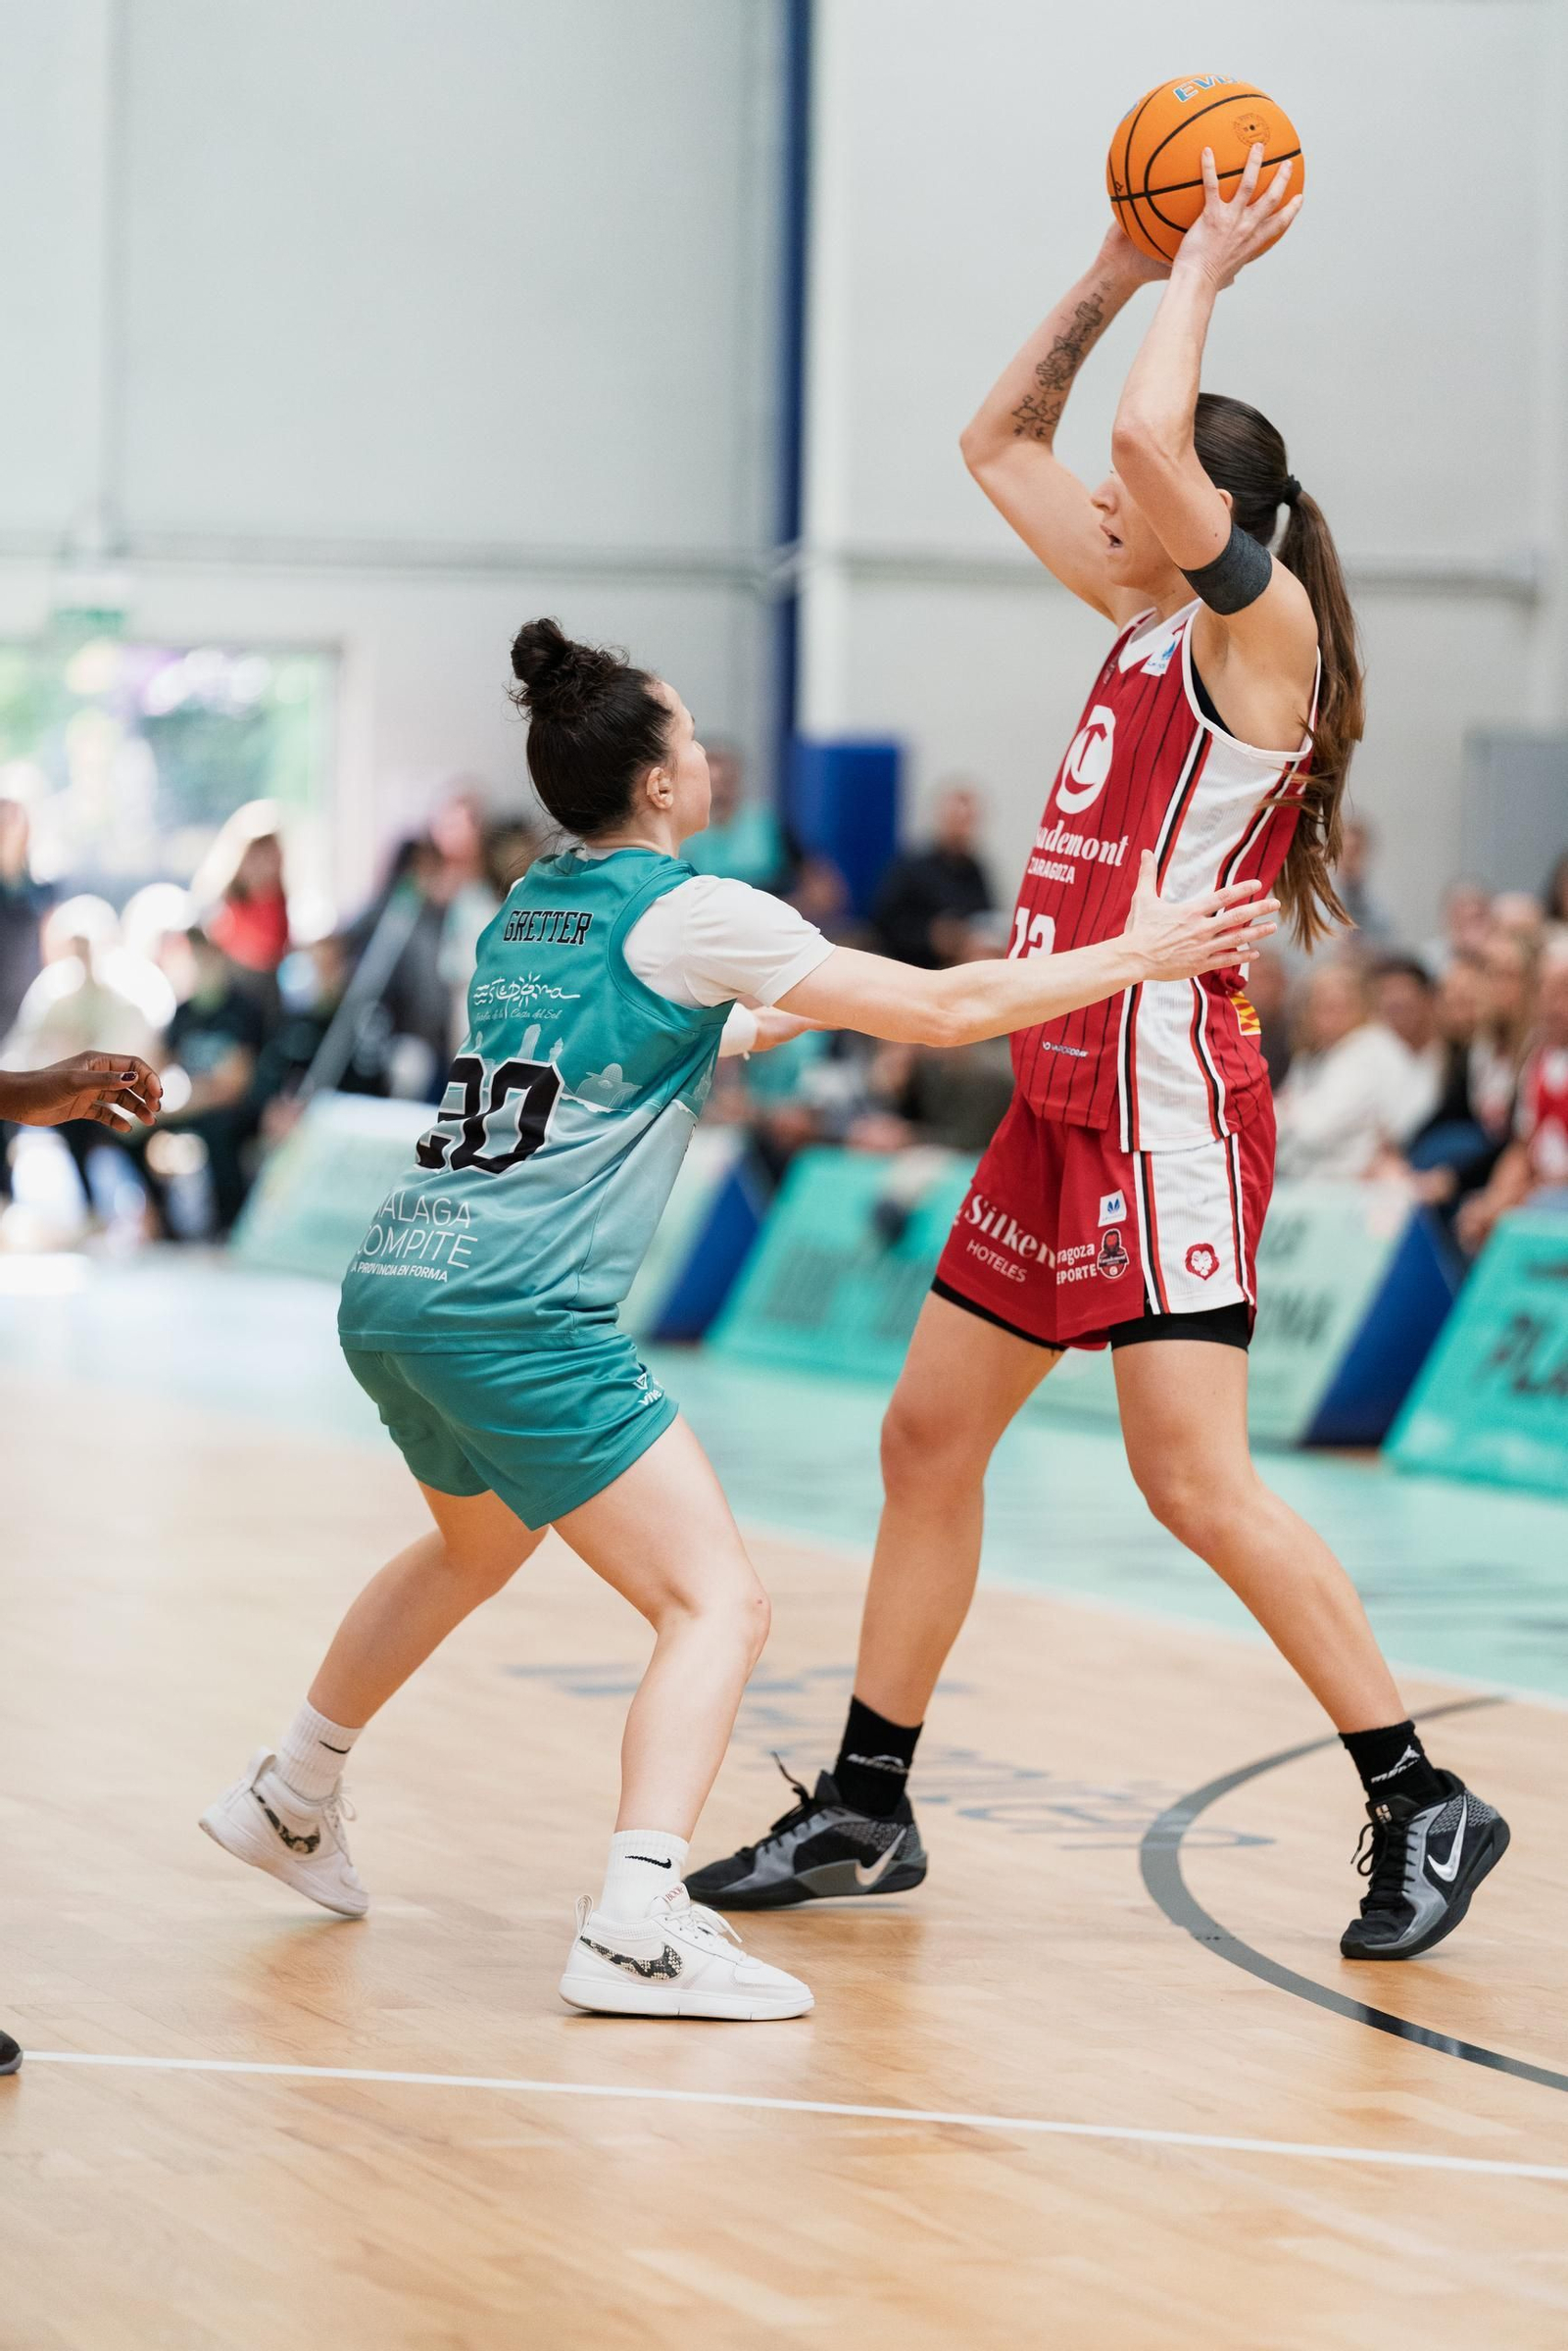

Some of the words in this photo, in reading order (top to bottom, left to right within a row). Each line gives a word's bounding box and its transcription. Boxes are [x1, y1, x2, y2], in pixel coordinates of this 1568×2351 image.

[1027, 856, 1076, 884] ZARAGOZA
[503, 909, 593, 946] GRETTER
[378, 1190, 471, 1229] ALAGA
[964, 1194, 1055, 1269] Silken
[965, 1239, 1028, 1283] HOTELES
[1056, 1243, 1096, 1265] ragoza
[358, 1261, 396, 1276] PROVINCIA
[396, 1265, 410, 1277] EN
[408, 1265, 448, 1283] FORMA
[1056, 1263, 1098, 1285] EPORTE
